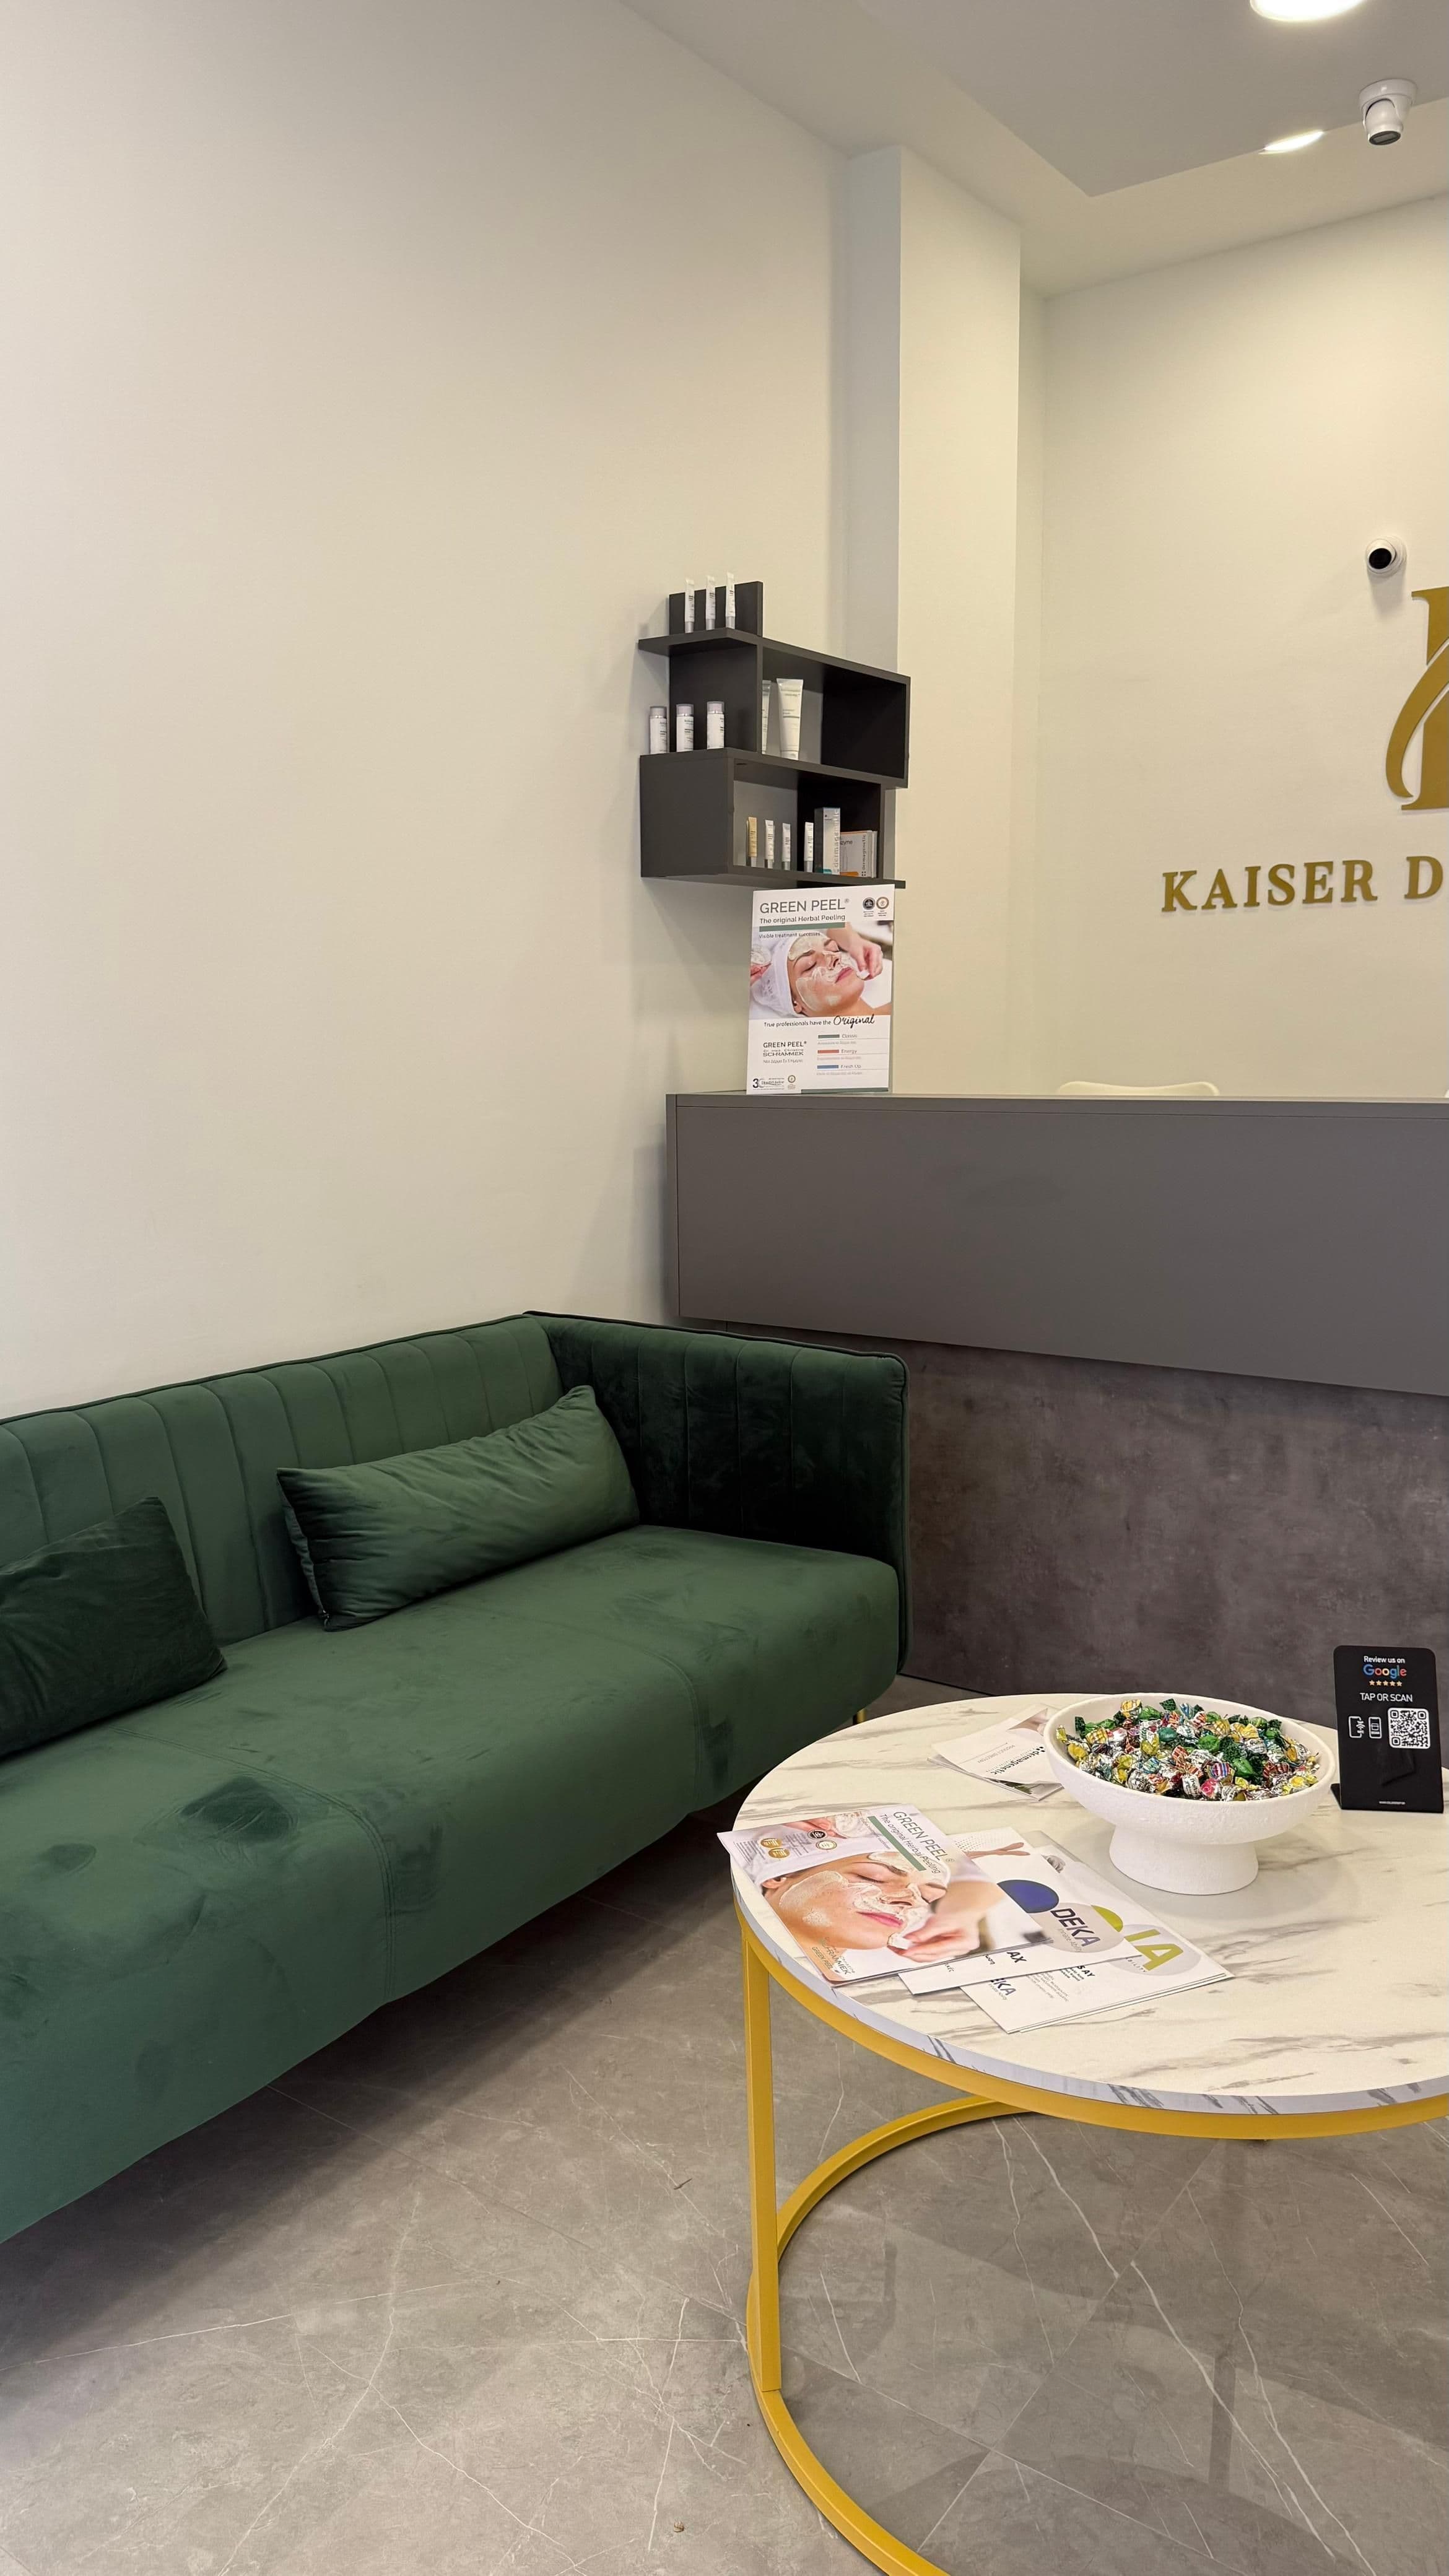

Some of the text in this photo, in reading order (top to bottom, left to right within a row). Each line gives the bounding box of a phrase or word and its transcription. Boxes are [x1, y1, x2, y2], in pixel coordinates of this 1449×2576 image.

[1162, 859, 1378, 912] KAISER
[760, 900, 807, 913] GREEN
[833, 1014, 875, 1029] Original
[1363, 1664, 1407, 1679] Google
[1360, 1692, 1412, 1702] TAP OR SCAN
[893, 1811, 929, 1839] GREEN
[880, 1814, 941, 1874] The original Herbal Peeling
[1050, 1908, 1101, 1947] DEKA
[1007, 1951, 1027, 1963] AX
[991, 1978, 1016, 1996] KA
